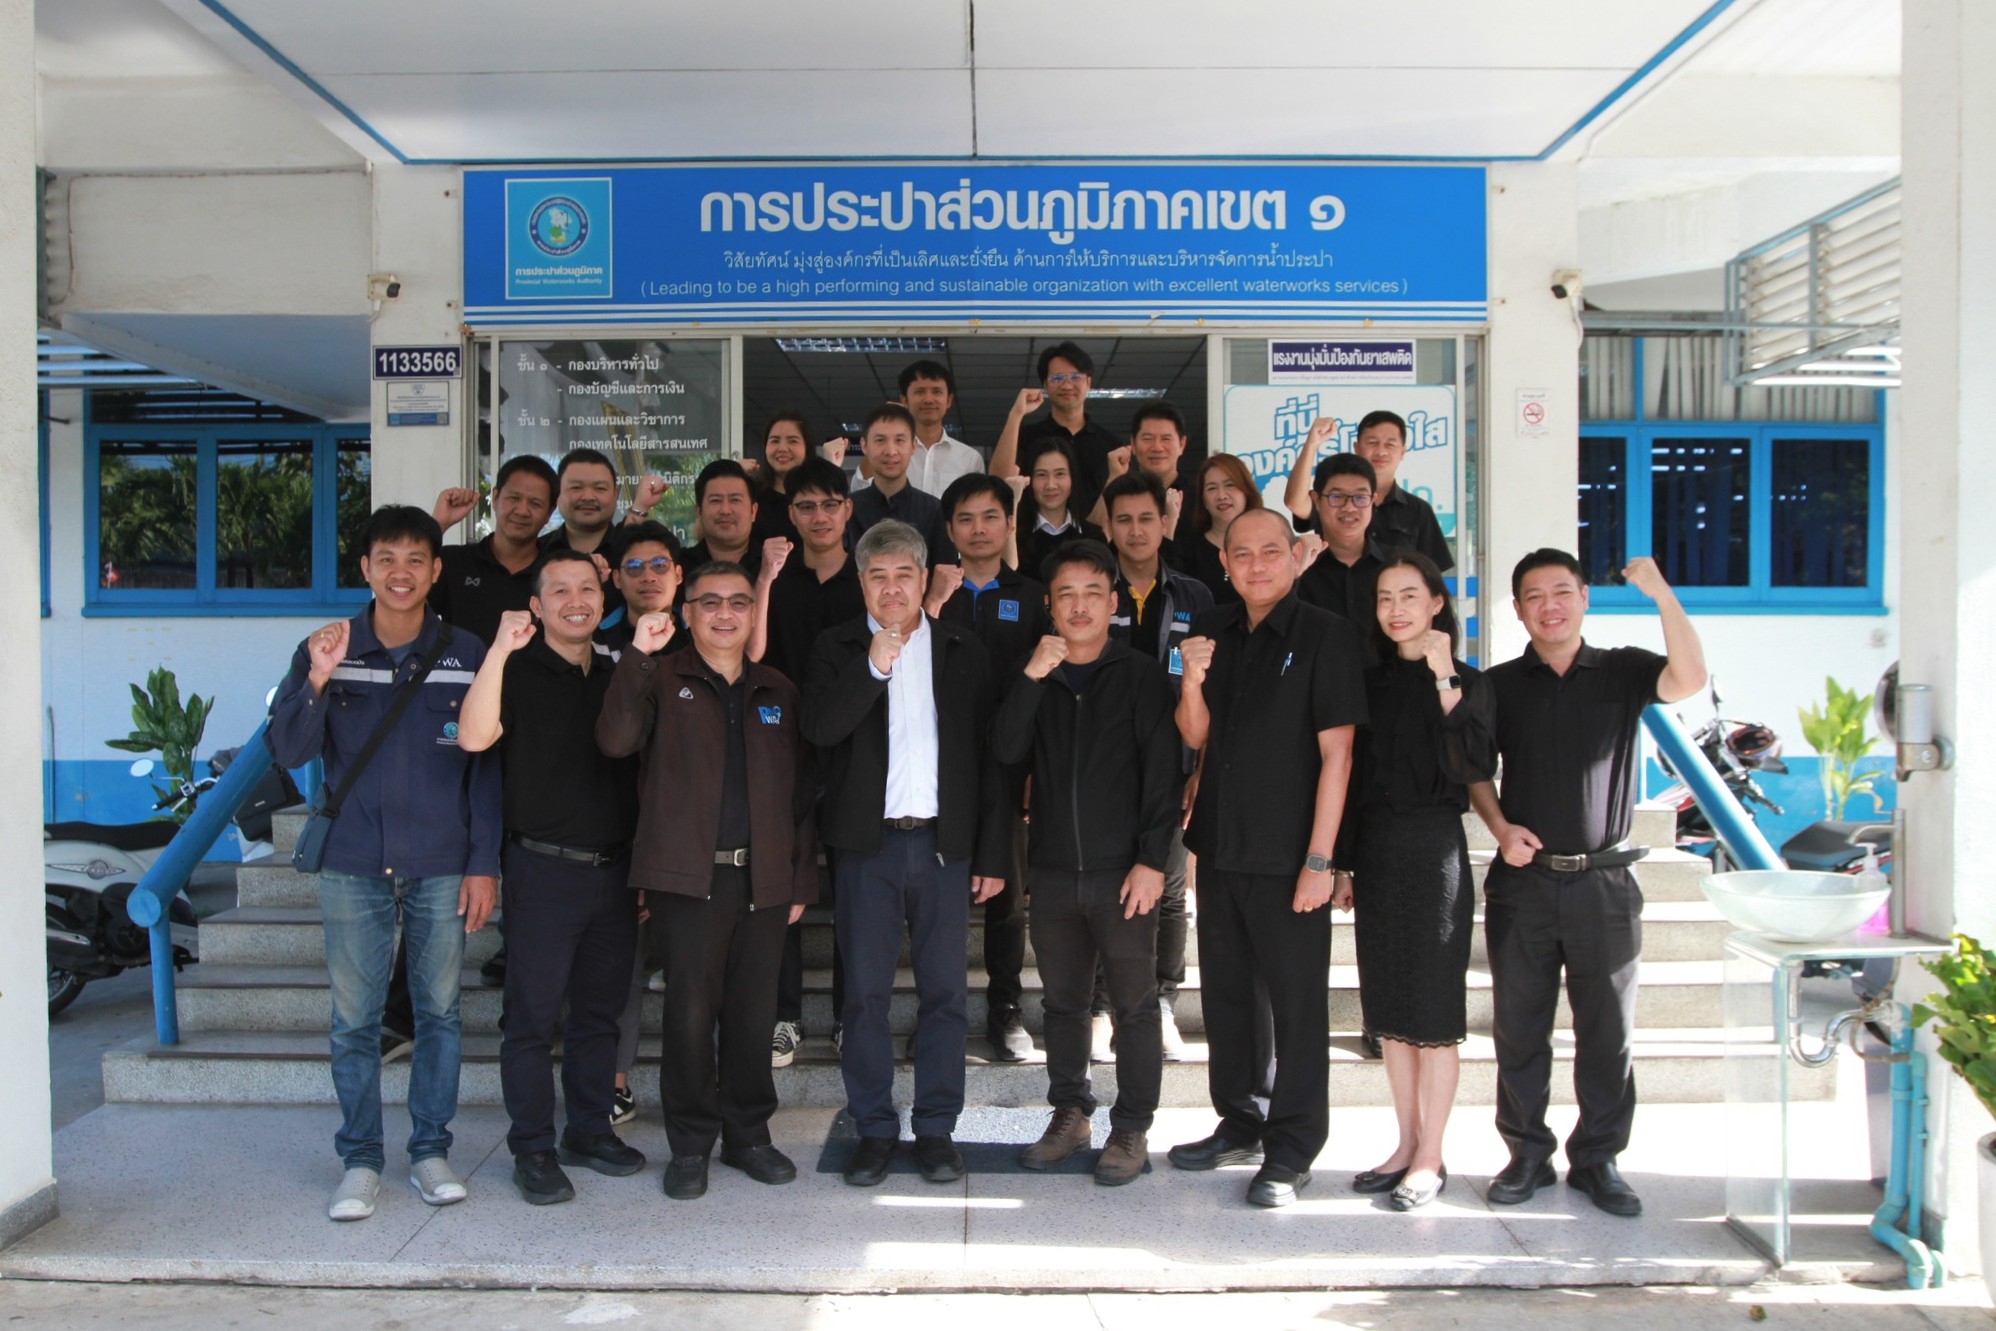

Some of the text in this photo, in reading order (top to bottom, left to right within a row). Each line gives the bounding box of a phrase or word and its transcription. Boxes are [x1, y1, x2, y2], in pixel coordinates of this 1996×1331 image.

[700, 178, 1346, 246] การประปาส่วนภูมิภาคเขต ๑
[723, 250, 790, 268] วิสัยทัศน์
[1013, 242, 1334, 267] ด้านการให้บริการและบริหารจัดการน้ำประปา
[718, 279, 732, 293] to
[737, 279, 757, 293] be
[762, 282, 771, 293] a
[776, 279, 810, 297] high
[815, 279, 899, 296] performing
[905, 278, 935, 292] and
[940, 278, 1028, 292] sustainable
[1032, 278, 1129, 296] organization
[1133, 278, 1164, 292] with
[1169, 278, 1239, 292] excellent
[1243, 278, 1330, 293] waterworks
[379, 351, 457, 373] 1133566
[517, 353, 535, 372] ชั้น
[568, 353, 659, 372] กองบริหารทั่วไป
[568, 380, 685, 398] กองบัญชีและการเงิน
[517, 408, 536, 426] ชั้น
[569, 412, 685, 427] กองแผนและวิชาการ
